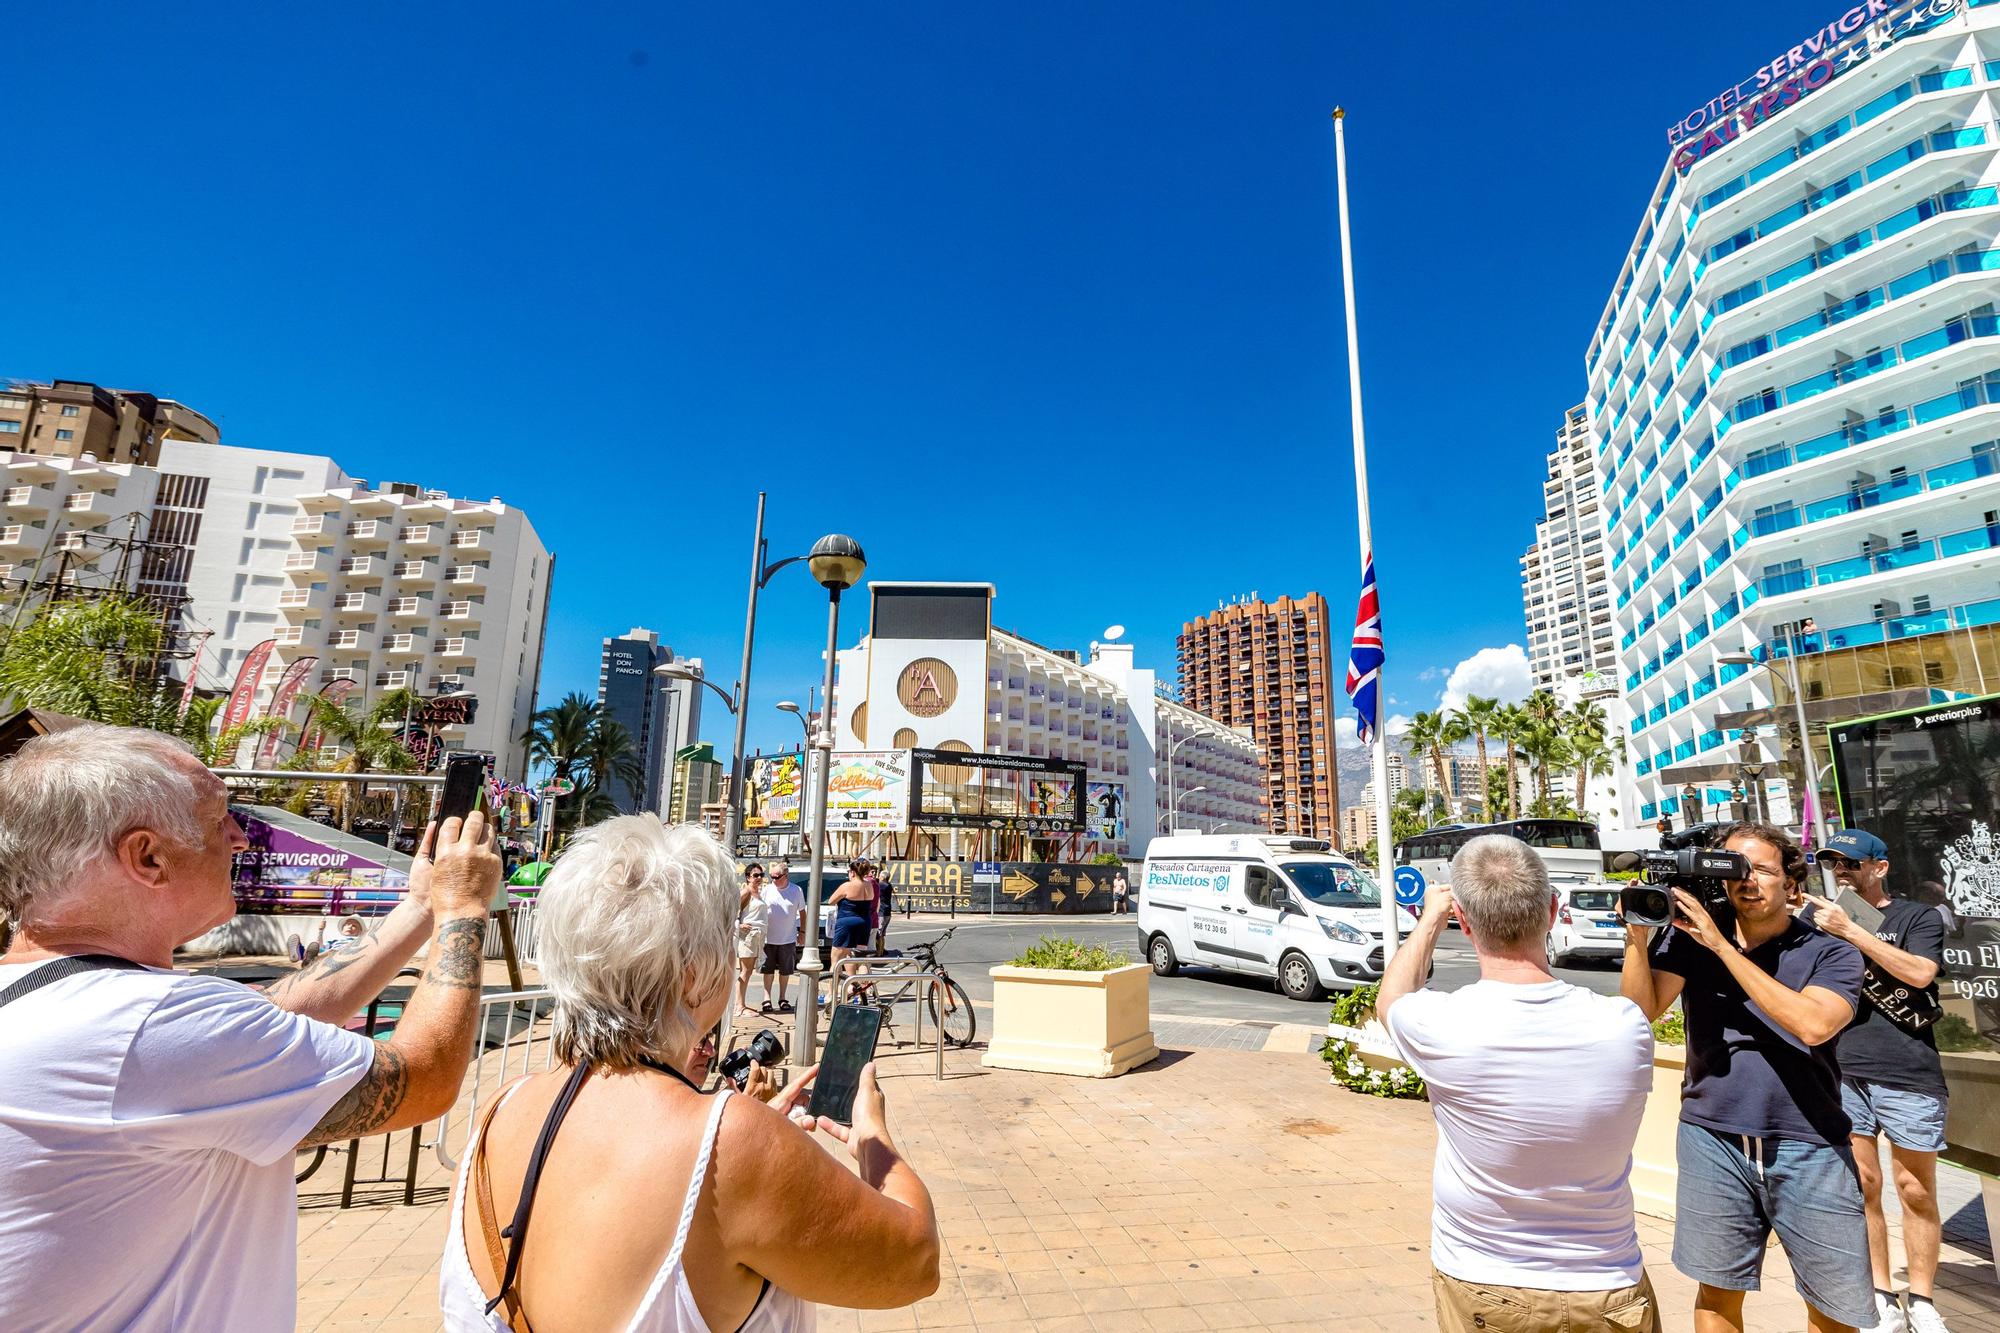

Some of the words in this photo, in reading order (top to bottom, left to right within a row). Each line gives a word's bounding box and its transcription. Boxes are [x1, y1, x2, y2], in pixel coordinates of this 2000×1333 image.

[1667, 84, 1748, 144] HOTEL
[1757, 0, 1894, 88] SERVIGR
[1673, 59, 1834, 169] CALYPSO
[615, 667, 643, 675] PANCHO
[1925, 705, 1982, 724] exteriorplus
[875, 760, 886, 770] LIVE
[886, 765, 905, 777] SPORTS
[961, 756, 1045, 769] www.hotelesbenidorm.com
[828, 773, 885, 792] California
[1095, 817, 1117, 826] DRINK
[261, 853, 348, 867] SERVIGROUP
[1150, 863, 1184, 872] Pescados
[1187, 863, 1231, 874] Cartagena
[1149, 873, 1210, 887] PesNietos
[897, 898, 926, 907] WTH
[1193, 922, 1203, 930] 968
[1212, 925, 1219, 933] 30
[1220, 926, 1227, 935] 65
[1943, 948, 1974, 966] en
[1952, 979, 1999, 999] 1926
[1862, 987, 1878, 1002] MADE
[1885, 1009, 1902, 1022] ITALY
[1864, 968, 1928, 1028] PLEIN
